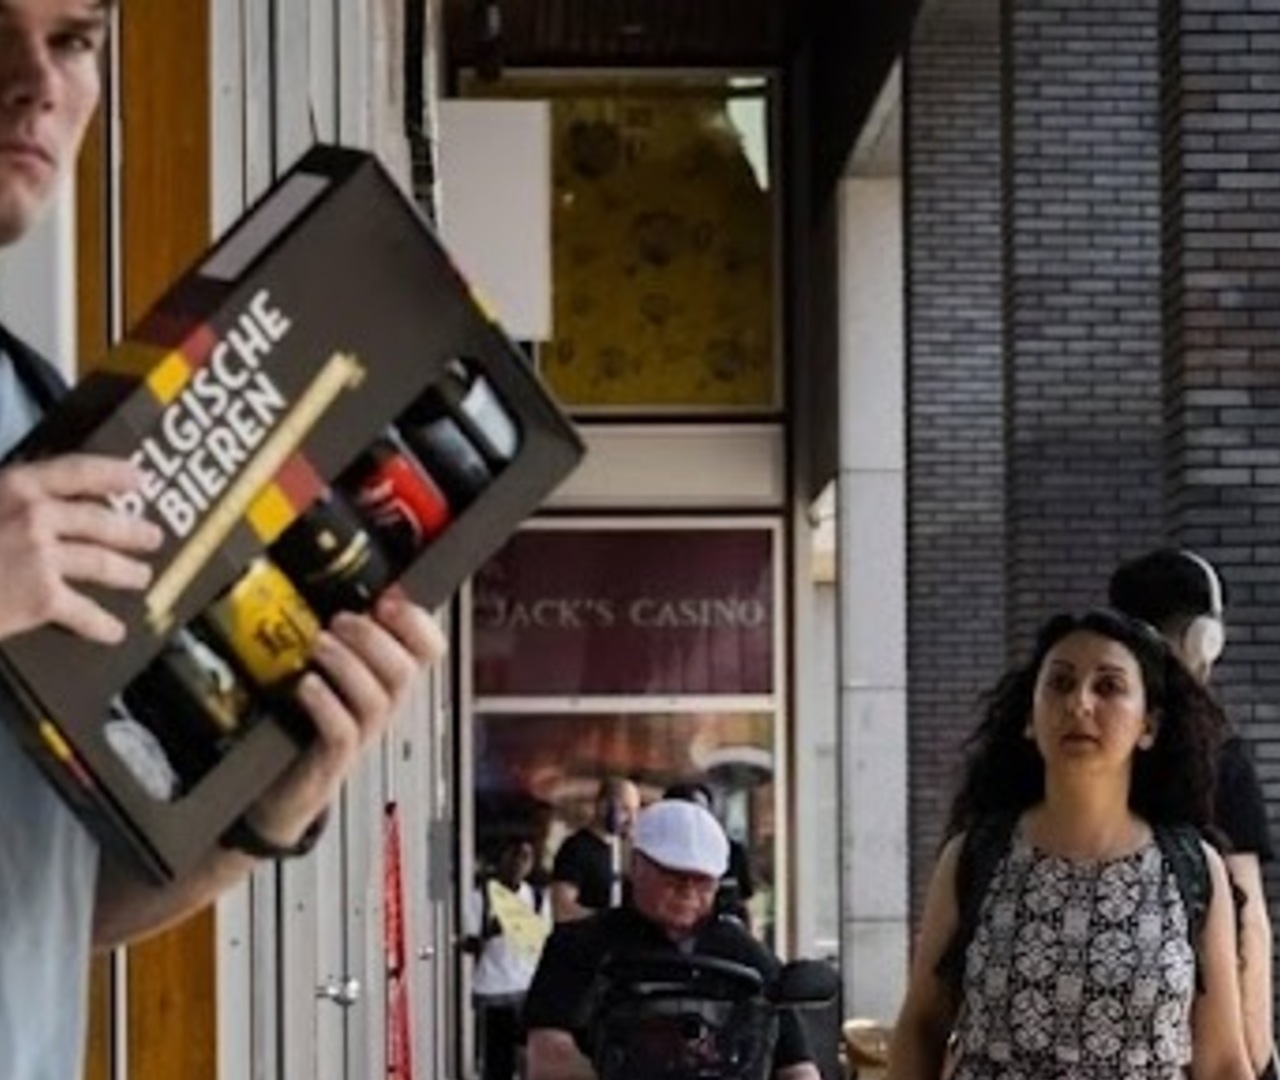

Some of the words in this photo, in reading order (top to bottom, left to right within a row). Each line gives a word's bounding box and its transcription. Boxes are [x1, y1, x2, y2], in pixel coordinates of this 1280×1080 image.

[156, 371, 287, 538] BIEREN
[489, 599, 615, 628] JACK'S
[628, 598, 766, 628] CASINO
